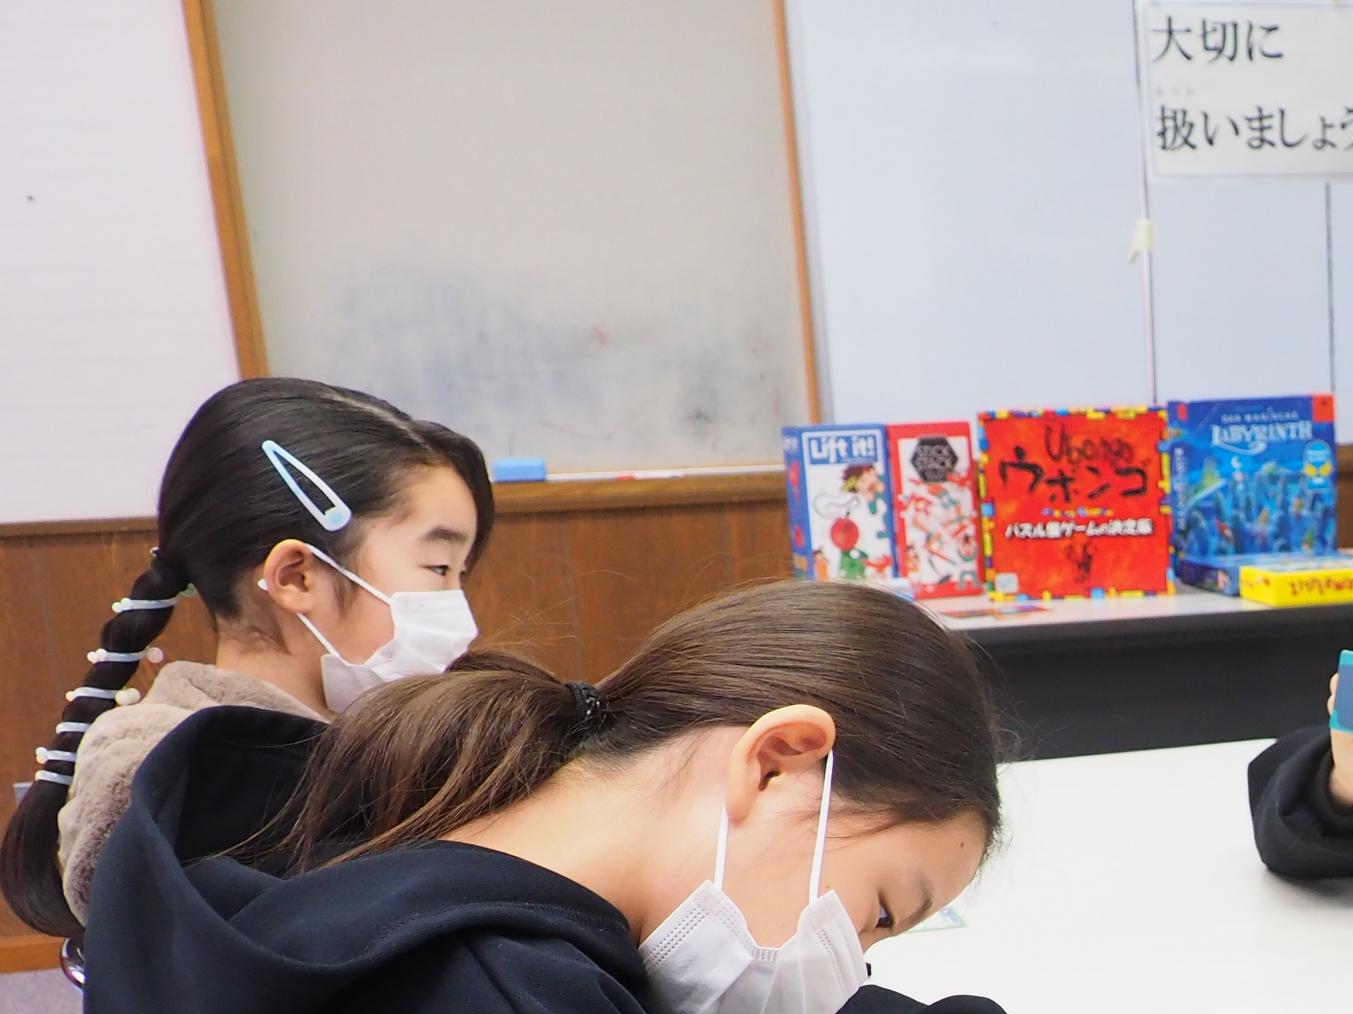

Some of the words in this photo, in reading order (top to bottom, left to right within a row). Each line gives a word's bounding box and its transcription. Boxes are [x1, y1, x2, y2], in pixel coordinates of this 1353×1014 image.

[1152, 16, 1284, 62] 大切に
[1211, 420, 1313, 446] LABYRINTH
[810, 435, 847, 463] Lift
[852, 435, 876, 457] it!
